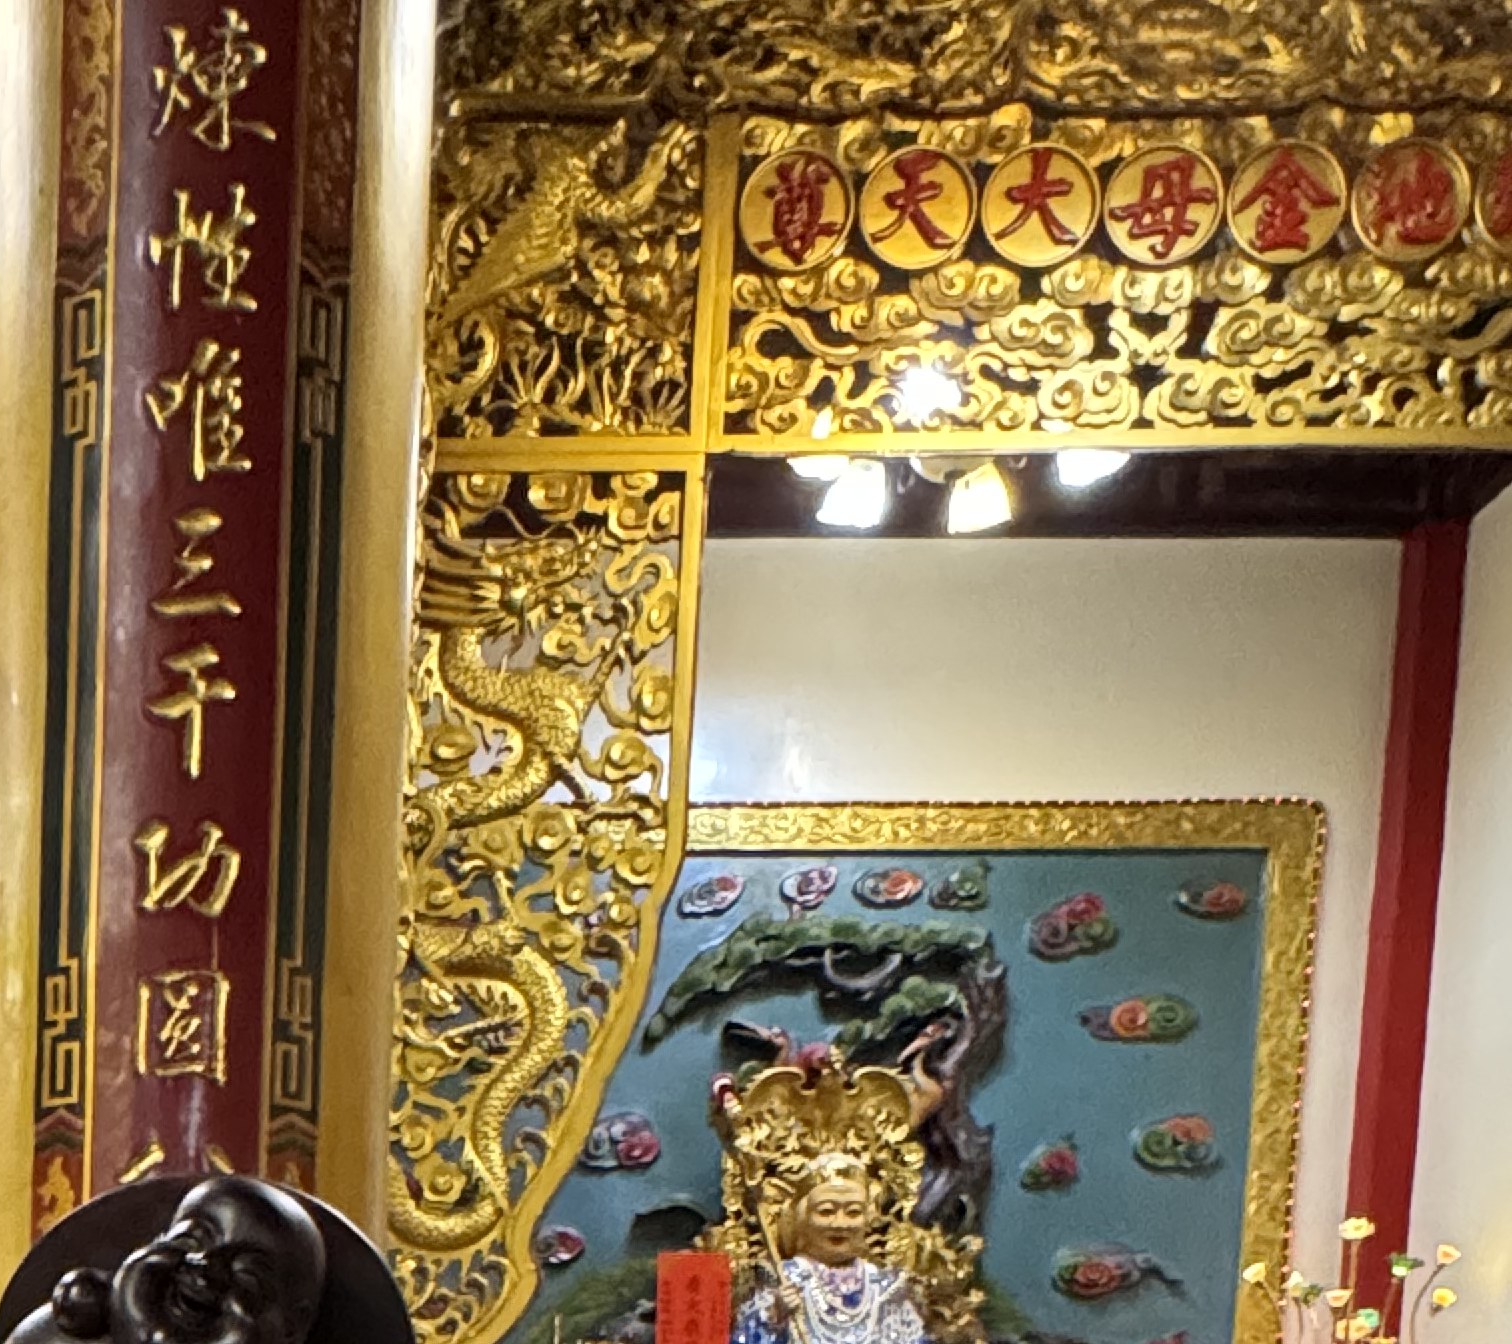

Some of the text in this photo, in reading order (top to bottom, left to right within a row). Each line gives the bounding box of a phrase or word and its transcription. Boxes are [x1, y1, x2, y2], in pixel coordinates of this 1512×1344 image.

[752, 147, 1512, 262] 池金母大天尊
